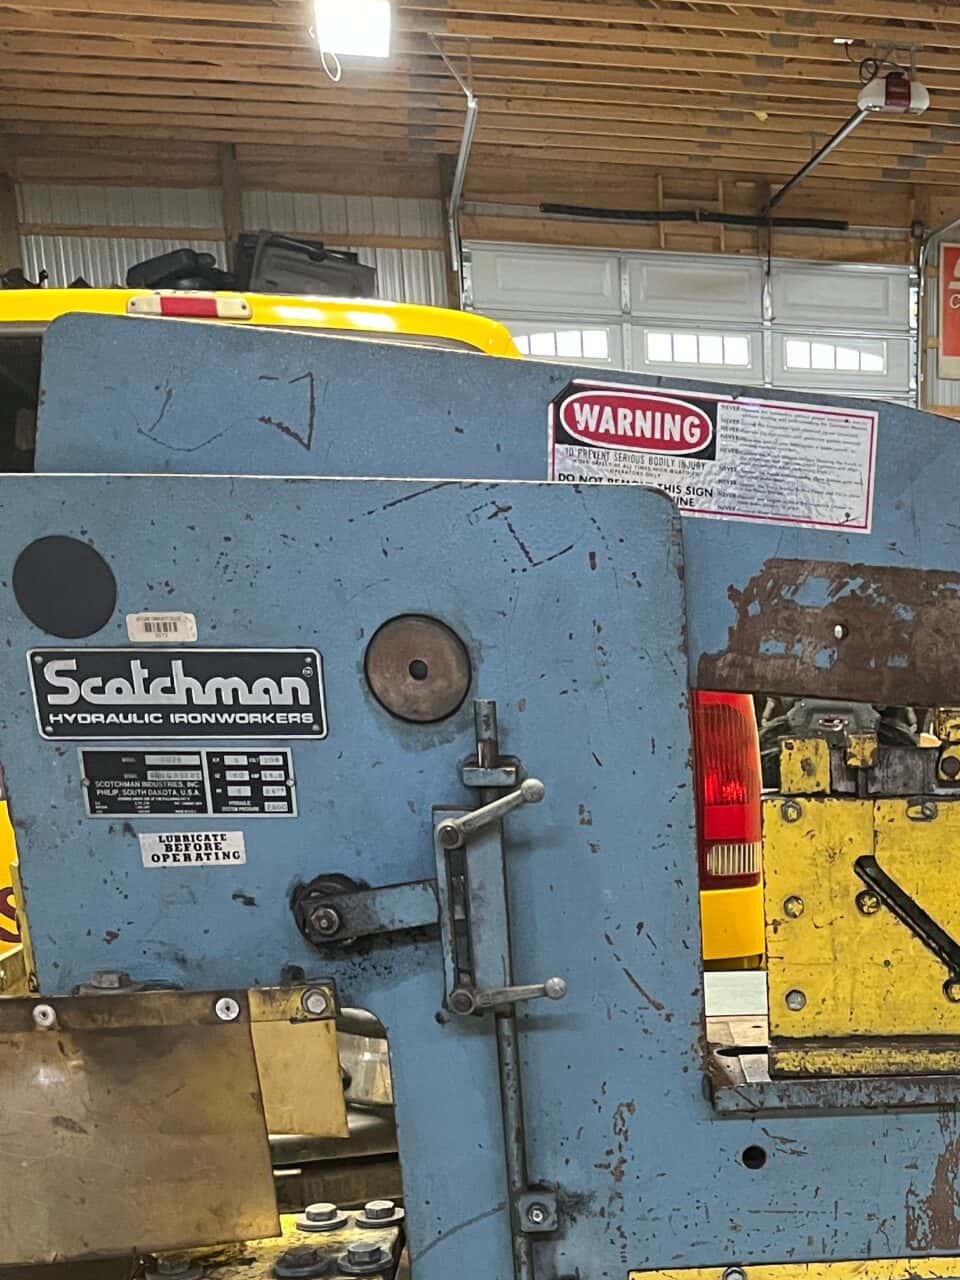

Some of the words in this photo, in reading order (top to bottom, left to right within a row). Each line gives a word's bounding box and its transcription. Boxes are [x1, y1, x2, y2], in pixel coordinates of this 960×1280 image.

[573, 403, 701, 444] WARNING
[614, 451, 645, 464] SERIOUS
[648, 455, 675, 467] BODILY
[678, 459, 705, 471] INJURY
[558, 473, 575, 482] DO
[685, 486, 713, 498] SIGN
[43, 659, 310, 705] Scotchman
[50, 712, 163, 725] HYDRAULIC
[169, 712, 314, 725] IRONWORKERS
[95, 780, 140, 788] SCOTCHMAN
[158, 833, 227, 843] LUBRICATE
[164, 842, 223, 852] BEFORE
[151, 850, 241, 863] OPERATING
